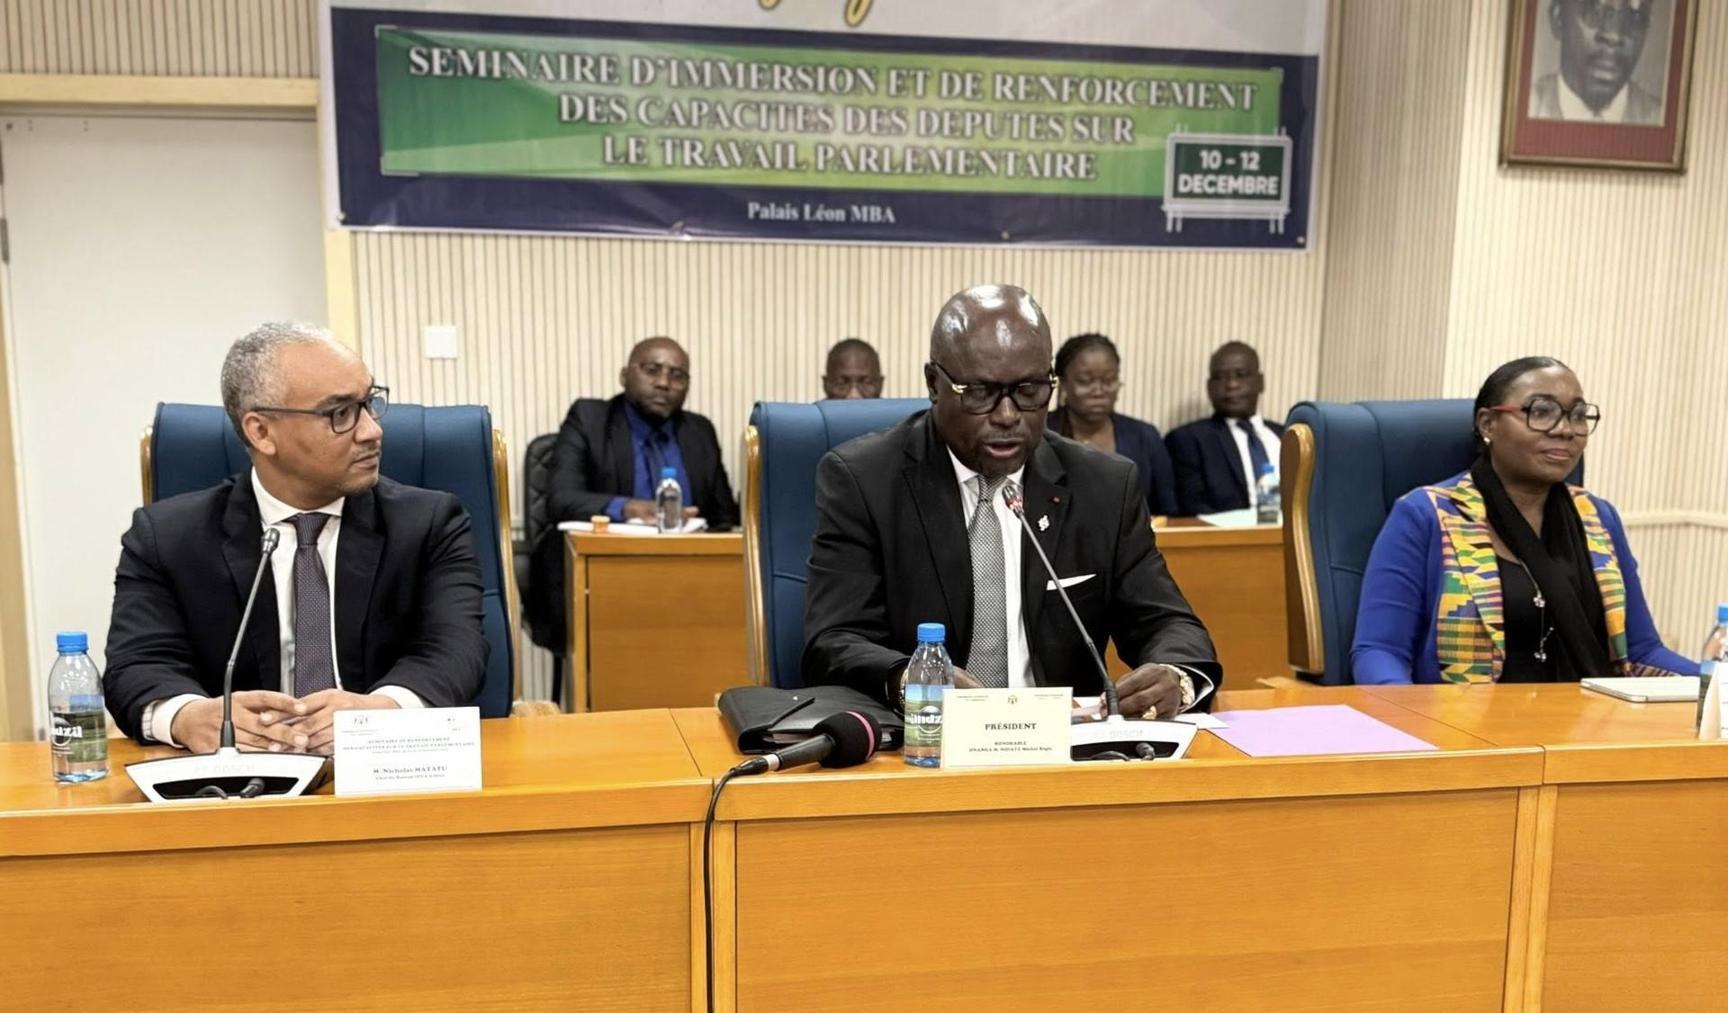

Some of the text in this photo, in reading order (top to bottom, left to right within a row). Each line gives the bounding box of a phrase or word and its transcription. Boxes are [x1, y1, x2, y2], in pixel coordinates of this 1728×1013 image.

[409, 46, 620, 85] SEMINAIRE
[888, 67, 930, 98] ET
[940, 70, 983, 101] DE
[993, 73, 1257, 111] RENFORCEMENT
[559, 94, 1134, 143] DES CAPACITES DES DEPUTES SUR
[603, 136, 1097, 180] LE TRAVAIL PARLEMENTAIRE
[1199, 150, 1222, 169] 10
[1239, 151, 1260, 170] 12
[1178, 174, 1279, 196] DECEMBRE
[748, 202, 896, 224] Palais Léon MBA
[985, 721, 1037, 731] PRÉSIDENT
